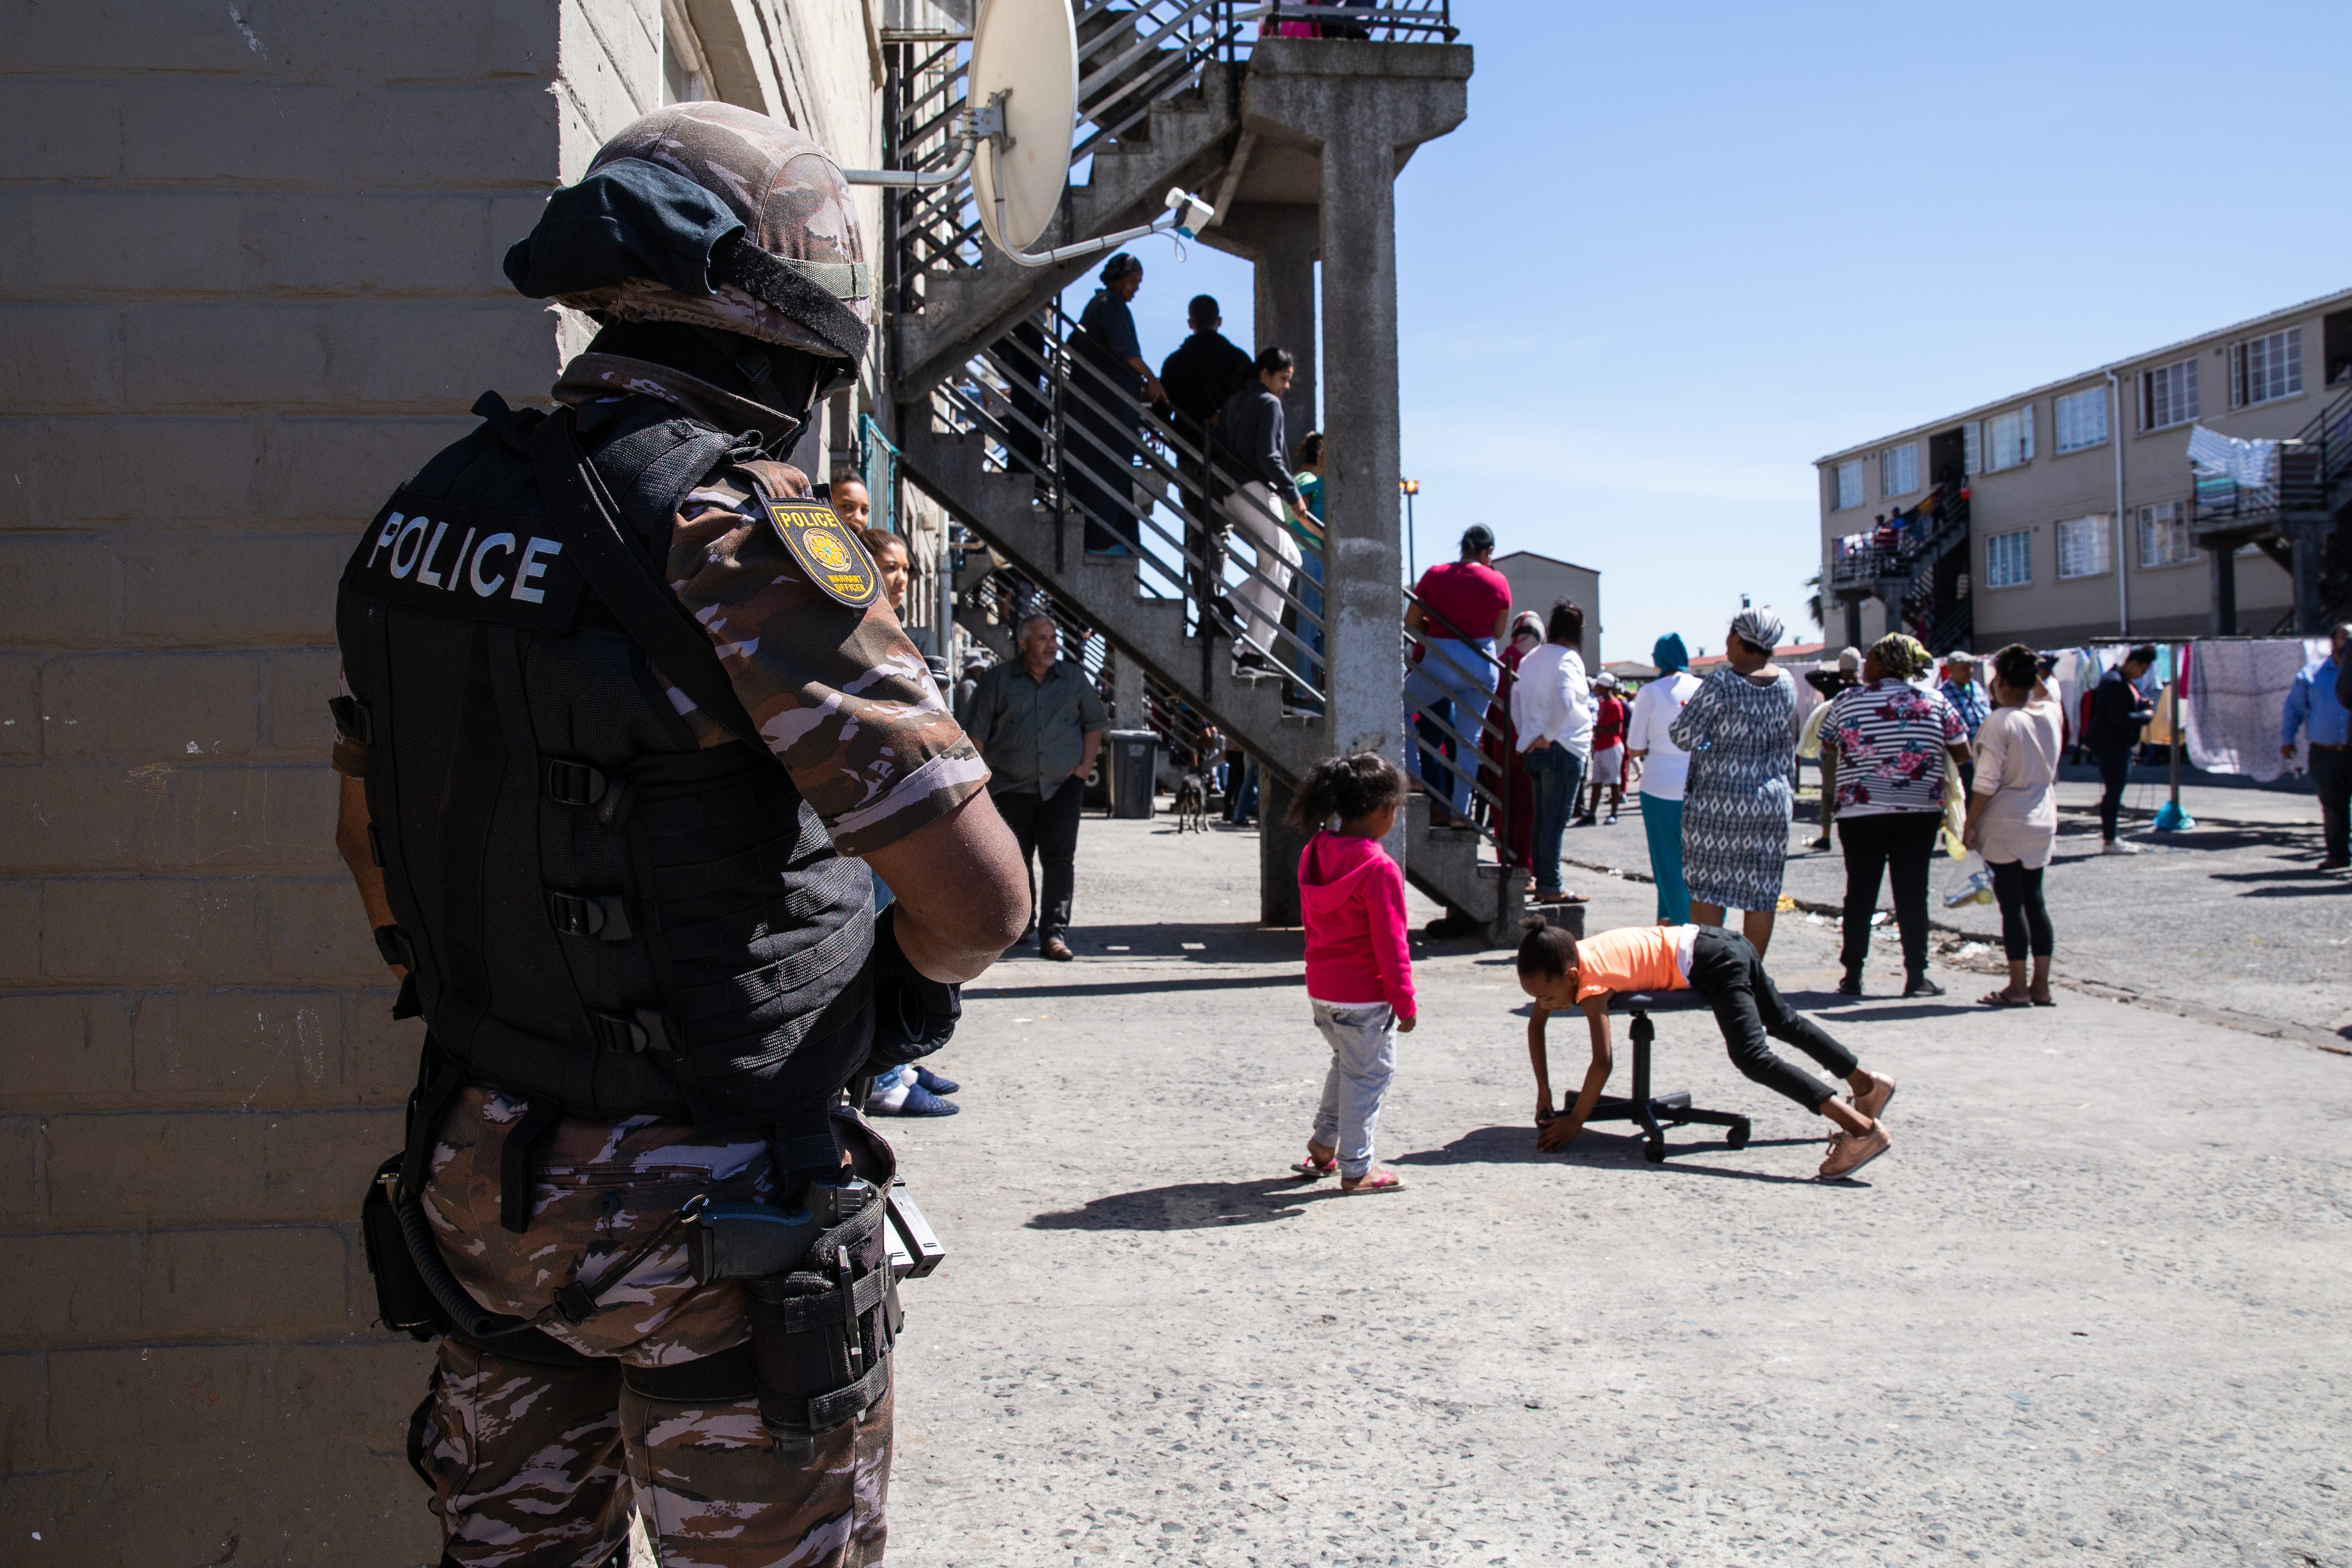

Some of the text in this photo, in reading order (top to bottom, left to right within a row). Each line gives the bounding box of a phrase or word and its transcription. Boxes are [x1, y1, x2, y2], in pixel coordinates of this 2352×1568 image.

[778, 512, 838, 527] POLICE
[367, 511, 563, 604] POLICE
[834, 583, 866, 592] OFFICER
